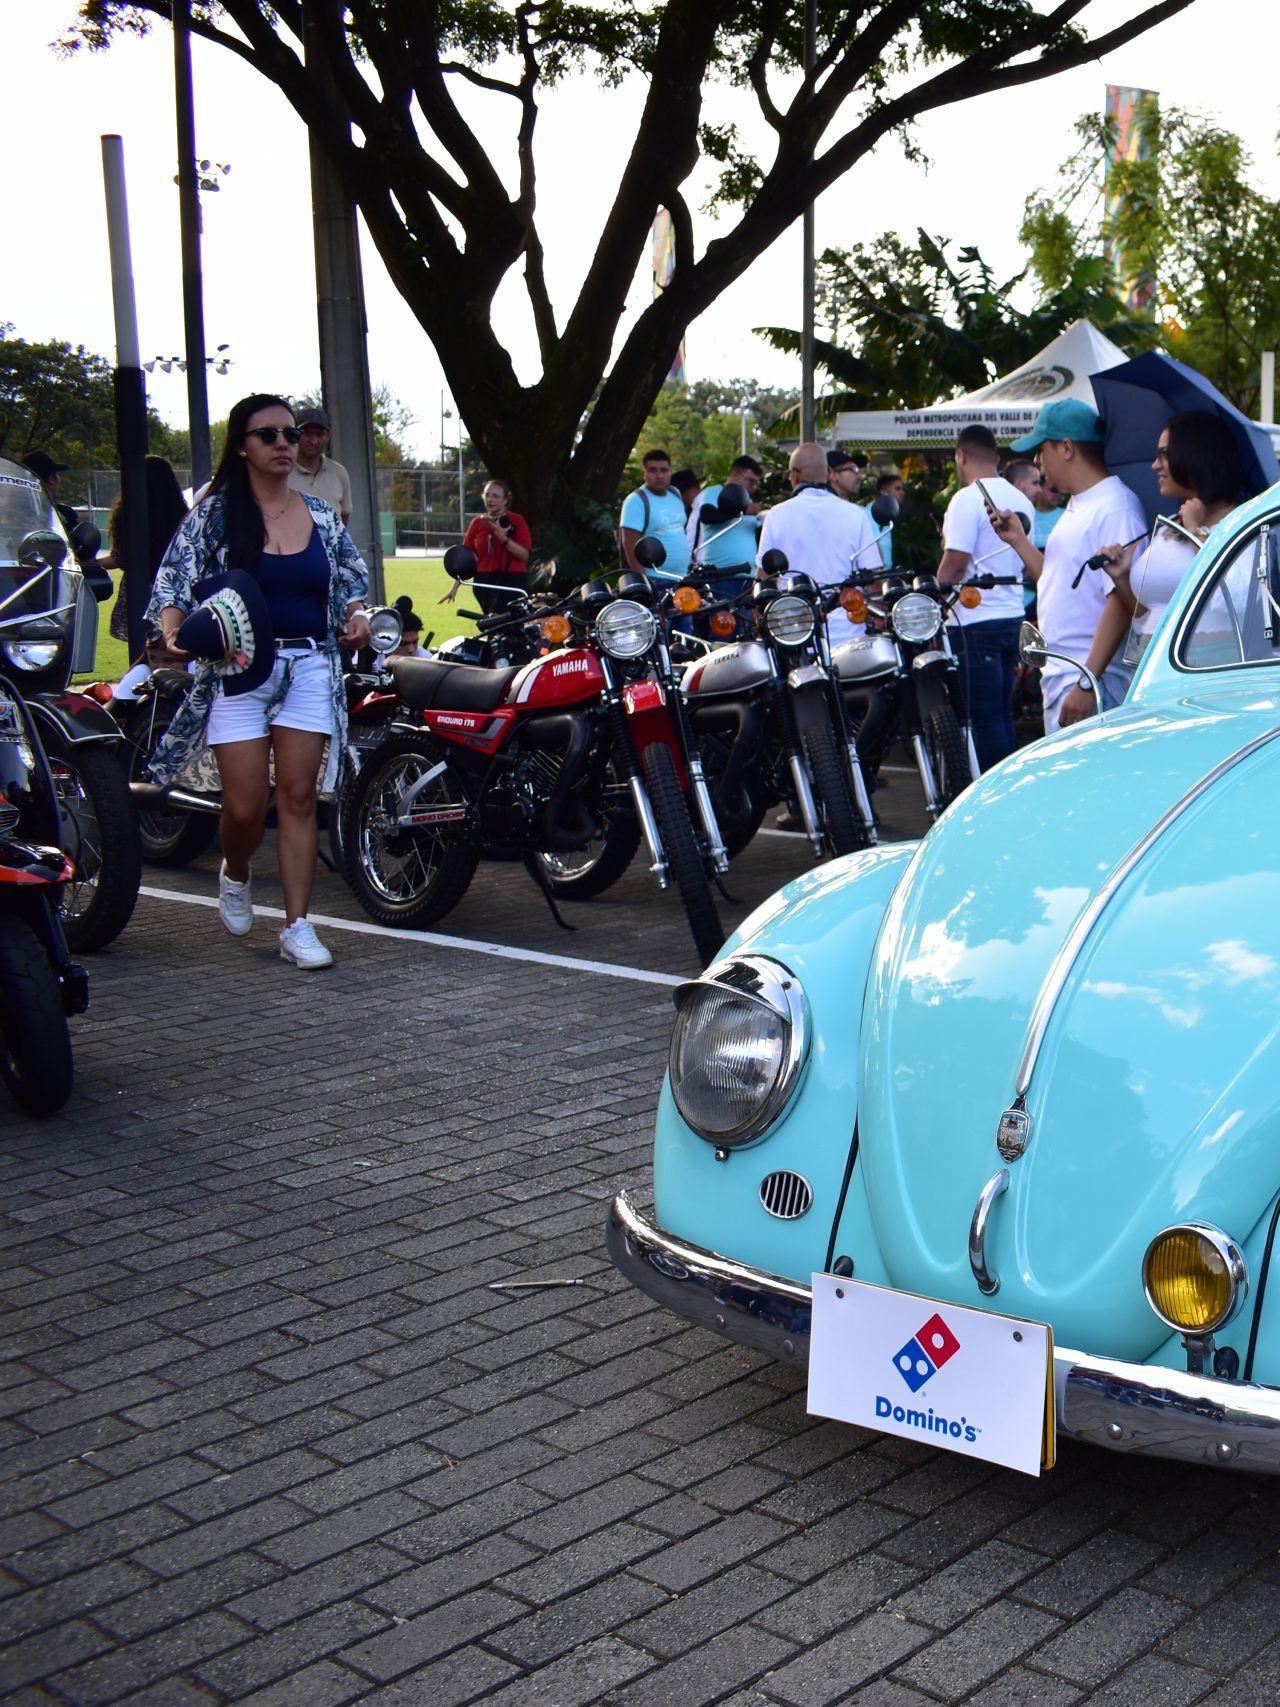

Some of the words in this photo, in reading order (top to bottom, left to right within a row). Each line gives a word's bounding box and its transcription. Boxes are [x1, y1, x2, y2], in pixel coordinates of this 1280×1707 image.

[924, 411, 983, 423] METROPOLITANA
[984, 411, 998, 422] DEL
[1000, 411, 1020, 421] VALLE
[1023, 411, 1032, 421] DE
[906, 427, 955, 438] DEPENDENCIA
[552, 658, 589, 678] YAMAHA
[436, 715, 463, 726] ENDURO
[875, 1395, 978, 1443] Domino's
